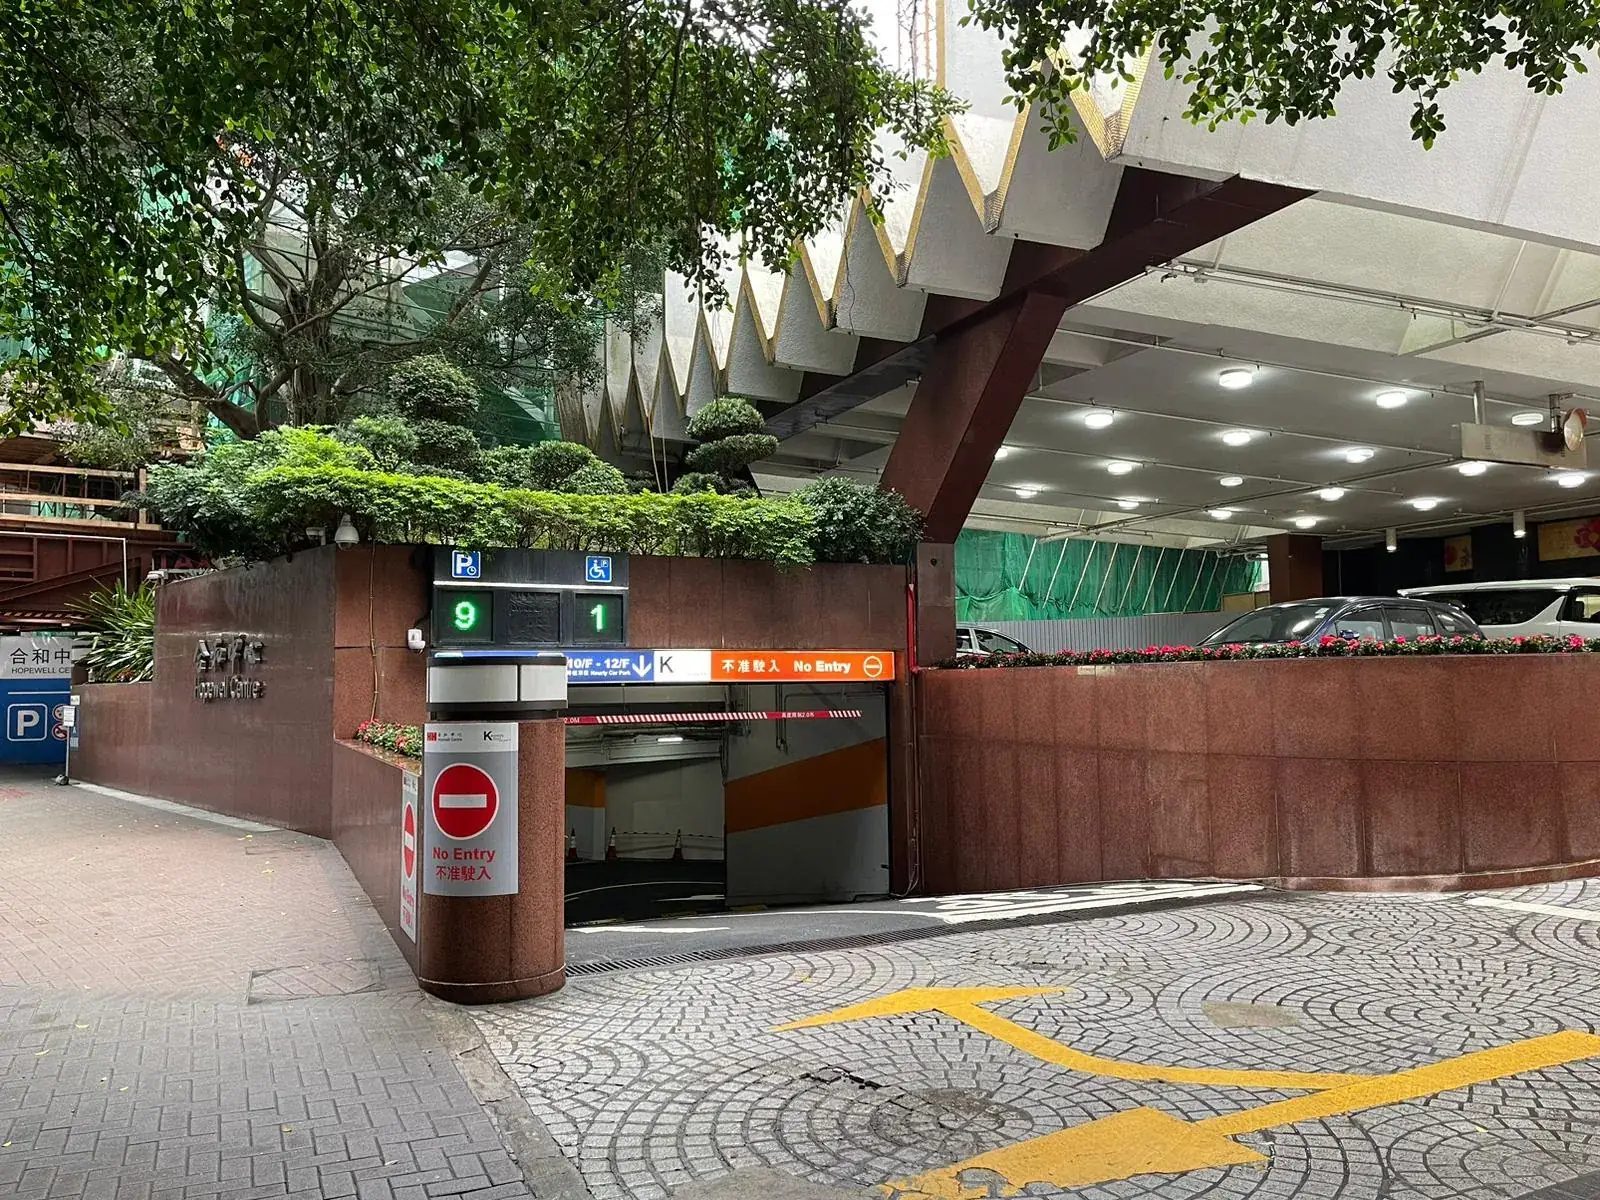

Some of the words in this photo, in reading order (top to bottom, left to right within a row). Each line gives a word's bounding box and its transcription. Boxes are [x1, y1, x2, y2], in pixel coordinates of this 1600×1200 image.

[455, 553, 472, 574] P
[454, 601, 475, 631] 9
[590, 603, 603, 632] 1
[10, 647, 71, 664] 合和中
[567, 658, 593, 669] 10/F
[604, 658, 630, 669] 12/F
[11, 666, 56, 674] HOPEWELL
[659, 656, 674, 673] K
[722, 659, 780, 673] 不准駛入
[793, 660, 812, 673] No
[815, 660, 851, 674] Entry
[17, 710, 40, 736] P
[483, 731, 493, 741] K
[432, 847, 449, 860] No
[453, 847, 496, 864] Entry
[435, 865, 492, 881] 不准駛入
